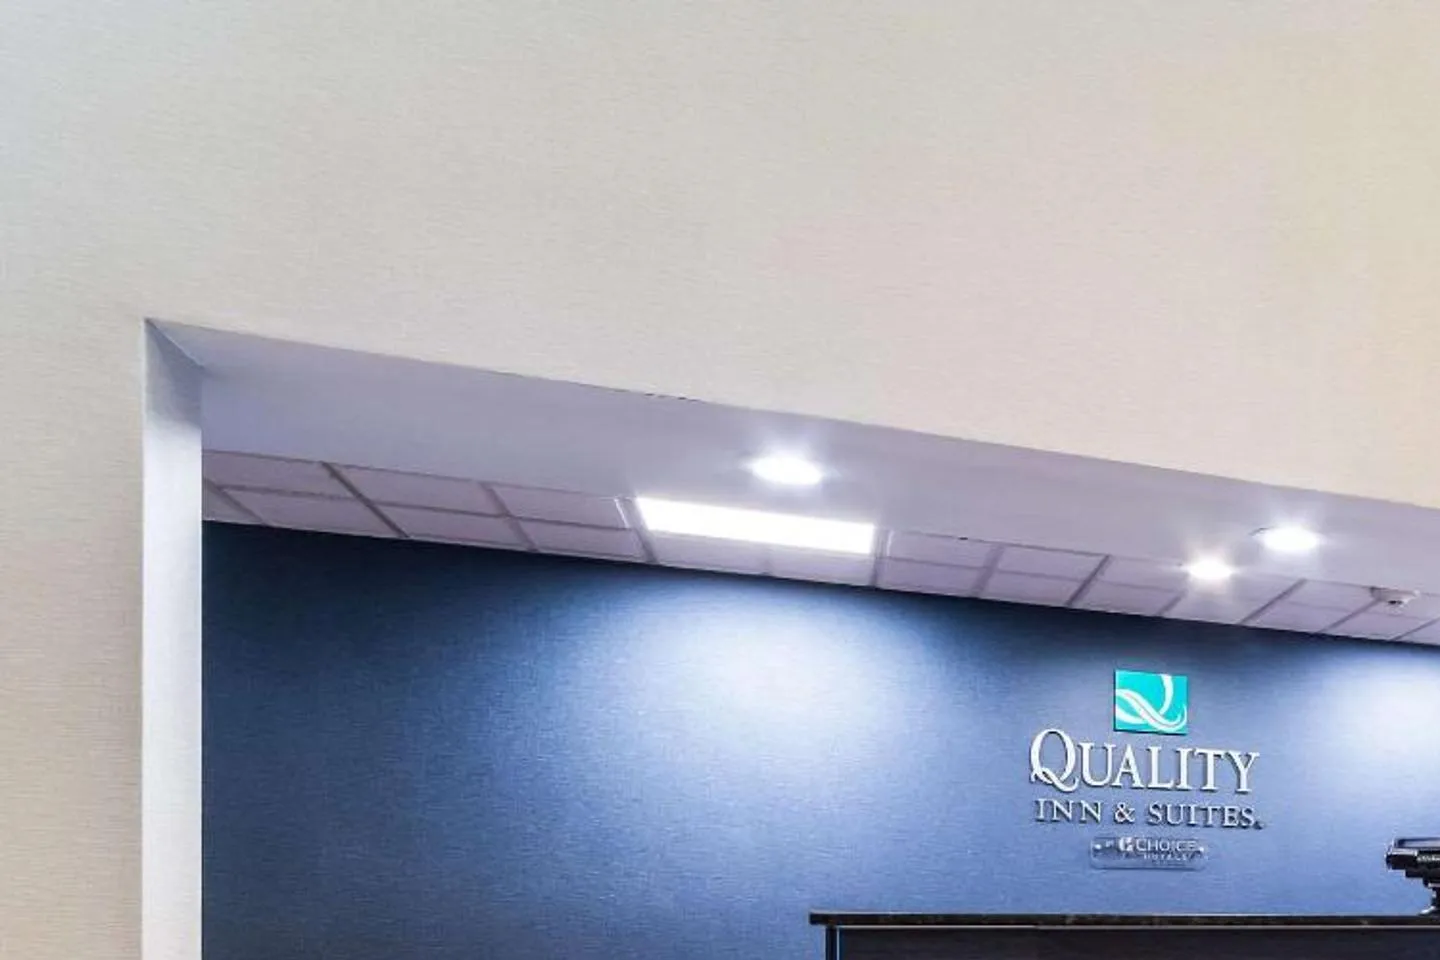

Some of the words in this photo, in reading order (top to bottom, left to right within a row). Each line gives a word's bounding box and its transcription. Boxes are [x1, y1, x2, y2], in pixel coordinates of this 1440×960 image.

[1030, 729, 1260, 793] QUALITY
[1036, 798, 1101, 822] INN
[1114, 801, 1136, 824] &
[1149, 801, 1256, 829] SUITES
[1136, 838, 1198, 852] CHOICE
